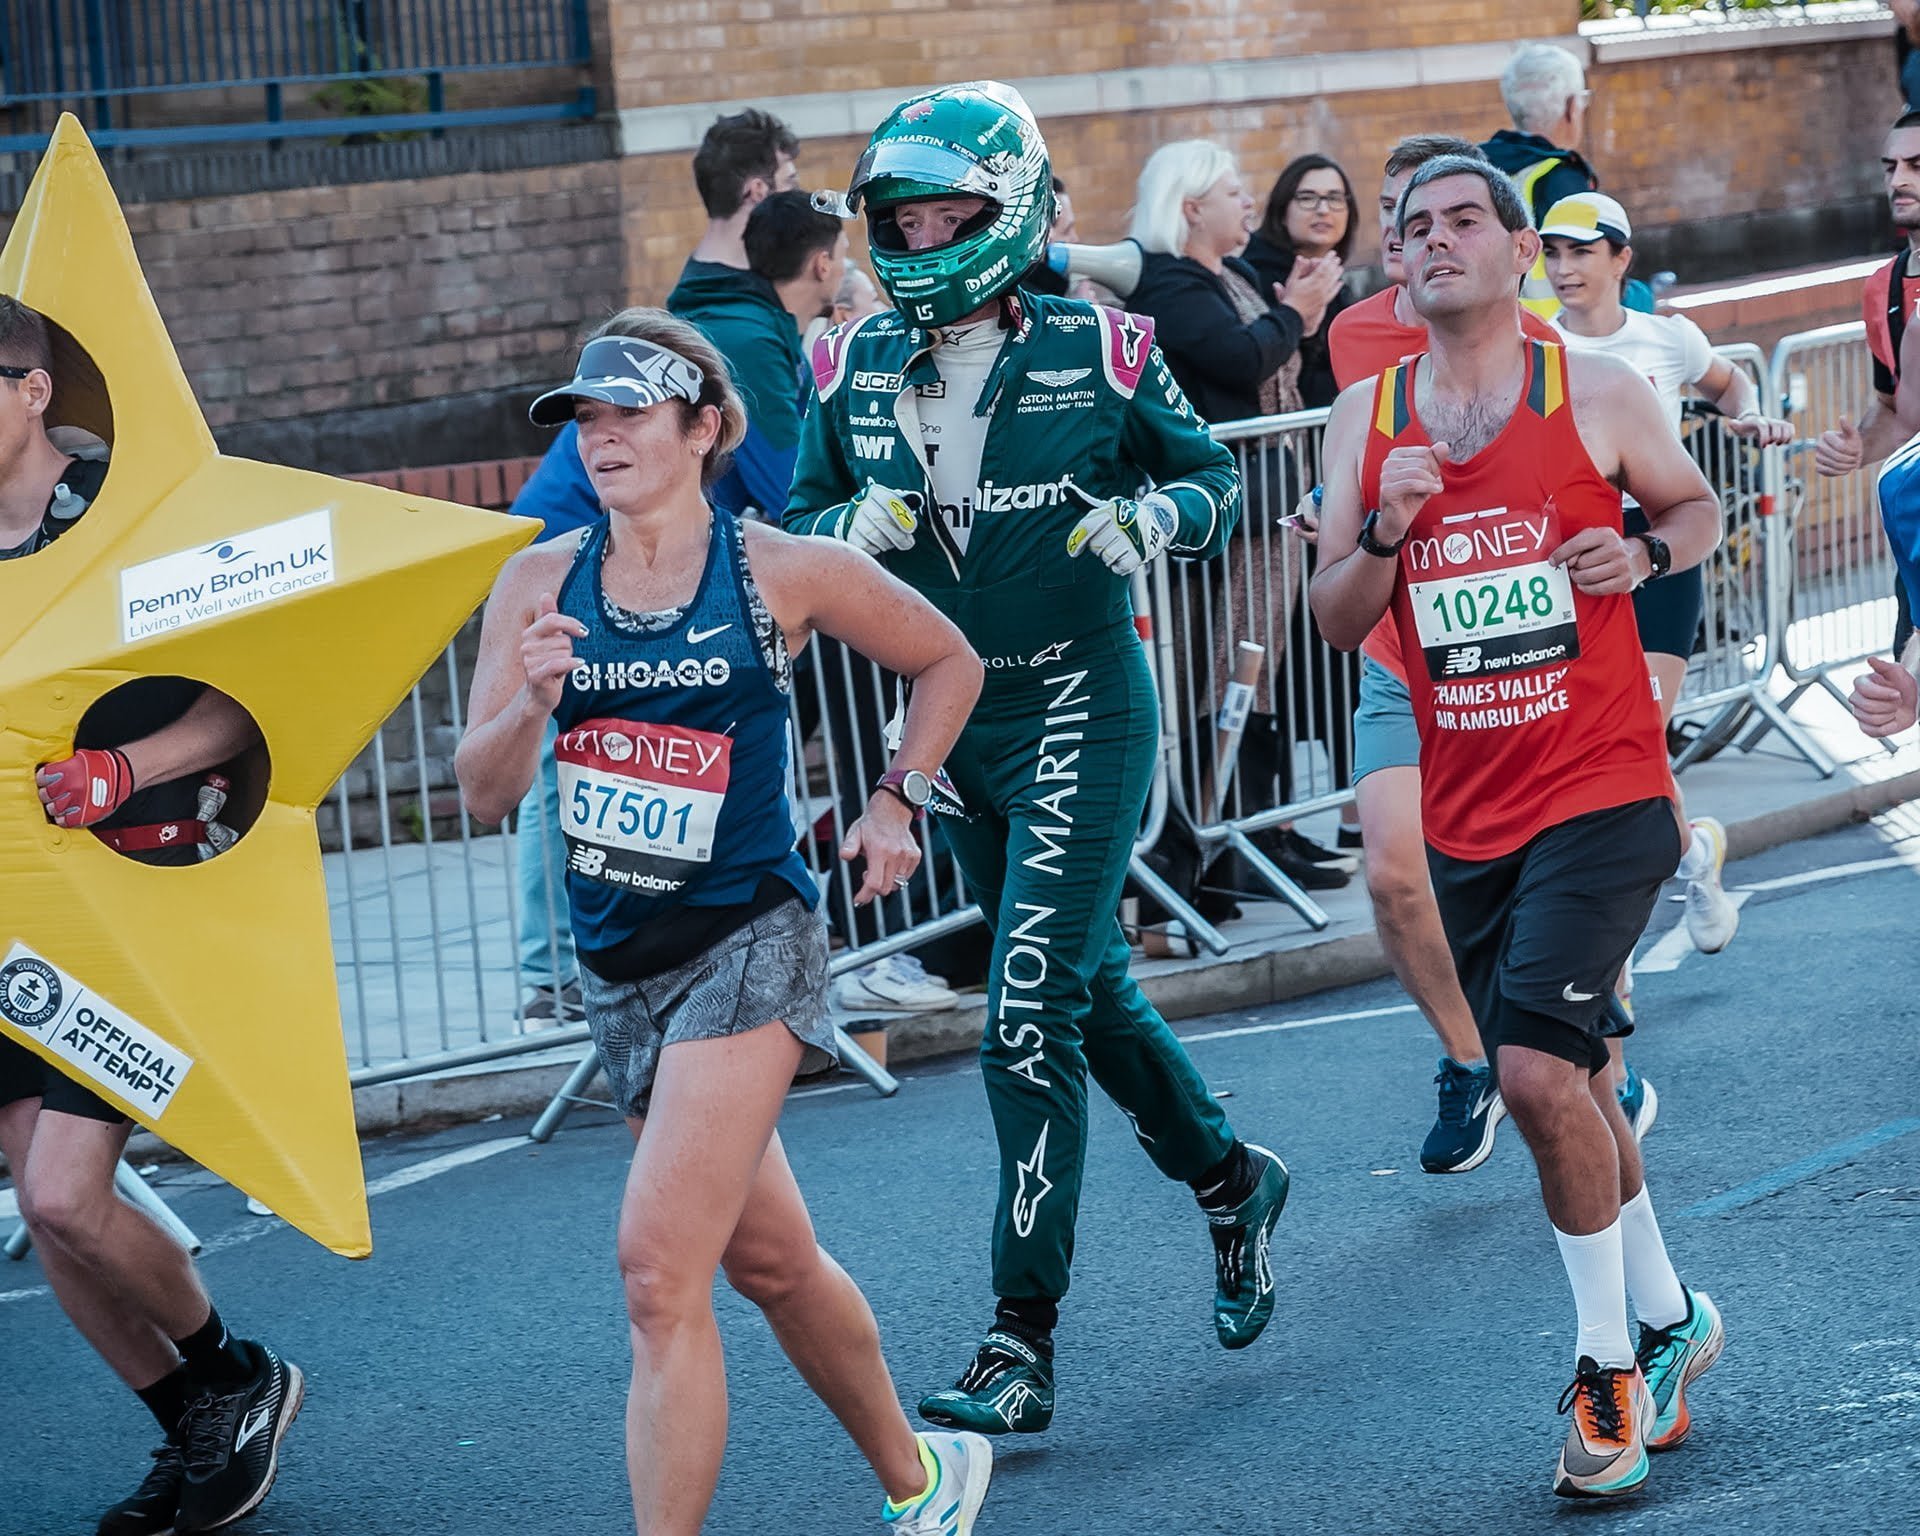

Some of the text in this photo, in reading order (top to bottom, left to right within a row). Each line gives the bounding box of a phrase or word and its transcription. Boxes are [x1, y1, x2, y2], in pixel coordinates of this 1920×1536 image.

[866, 134, 944, 153] STON MARTIN
[951, 143, 979, 162] PERONI
[980, 255, 1010, 286] BWT
[1017, 404, 1054, 414] FORMULA
[1018, 390, 1095, 405] ASTON MARTIN
[974, 473, 1070, 513] nizant
[129, 543, 328, 619] Penny Brohn UK
[130, 569, 329, 638] Living Well with Cancer
[1432, 575, 1553, 633] 10248
[981, 655, 1026, 669] ROLL
[1484, 644, 1566, 670] new balance
[572, 657, 730, 691] CHICAGO
[1436, 689, 1570, 730] AIR AMBULANCE
[573, 779, 693, 845] 57501
[930, 801, 964, 818] balan
[605, 868, 685, 891] new balanc
[998, 669, 1092, 1088] ASTON MARTIN
[15, 962, 60, 995] GUINNESS
[10, 1002, 56, 1023] RECORDS
[75, 1007, 176, 1087] OFFICIAL
[61, 1027, 170, 1104] ATTEMPT
